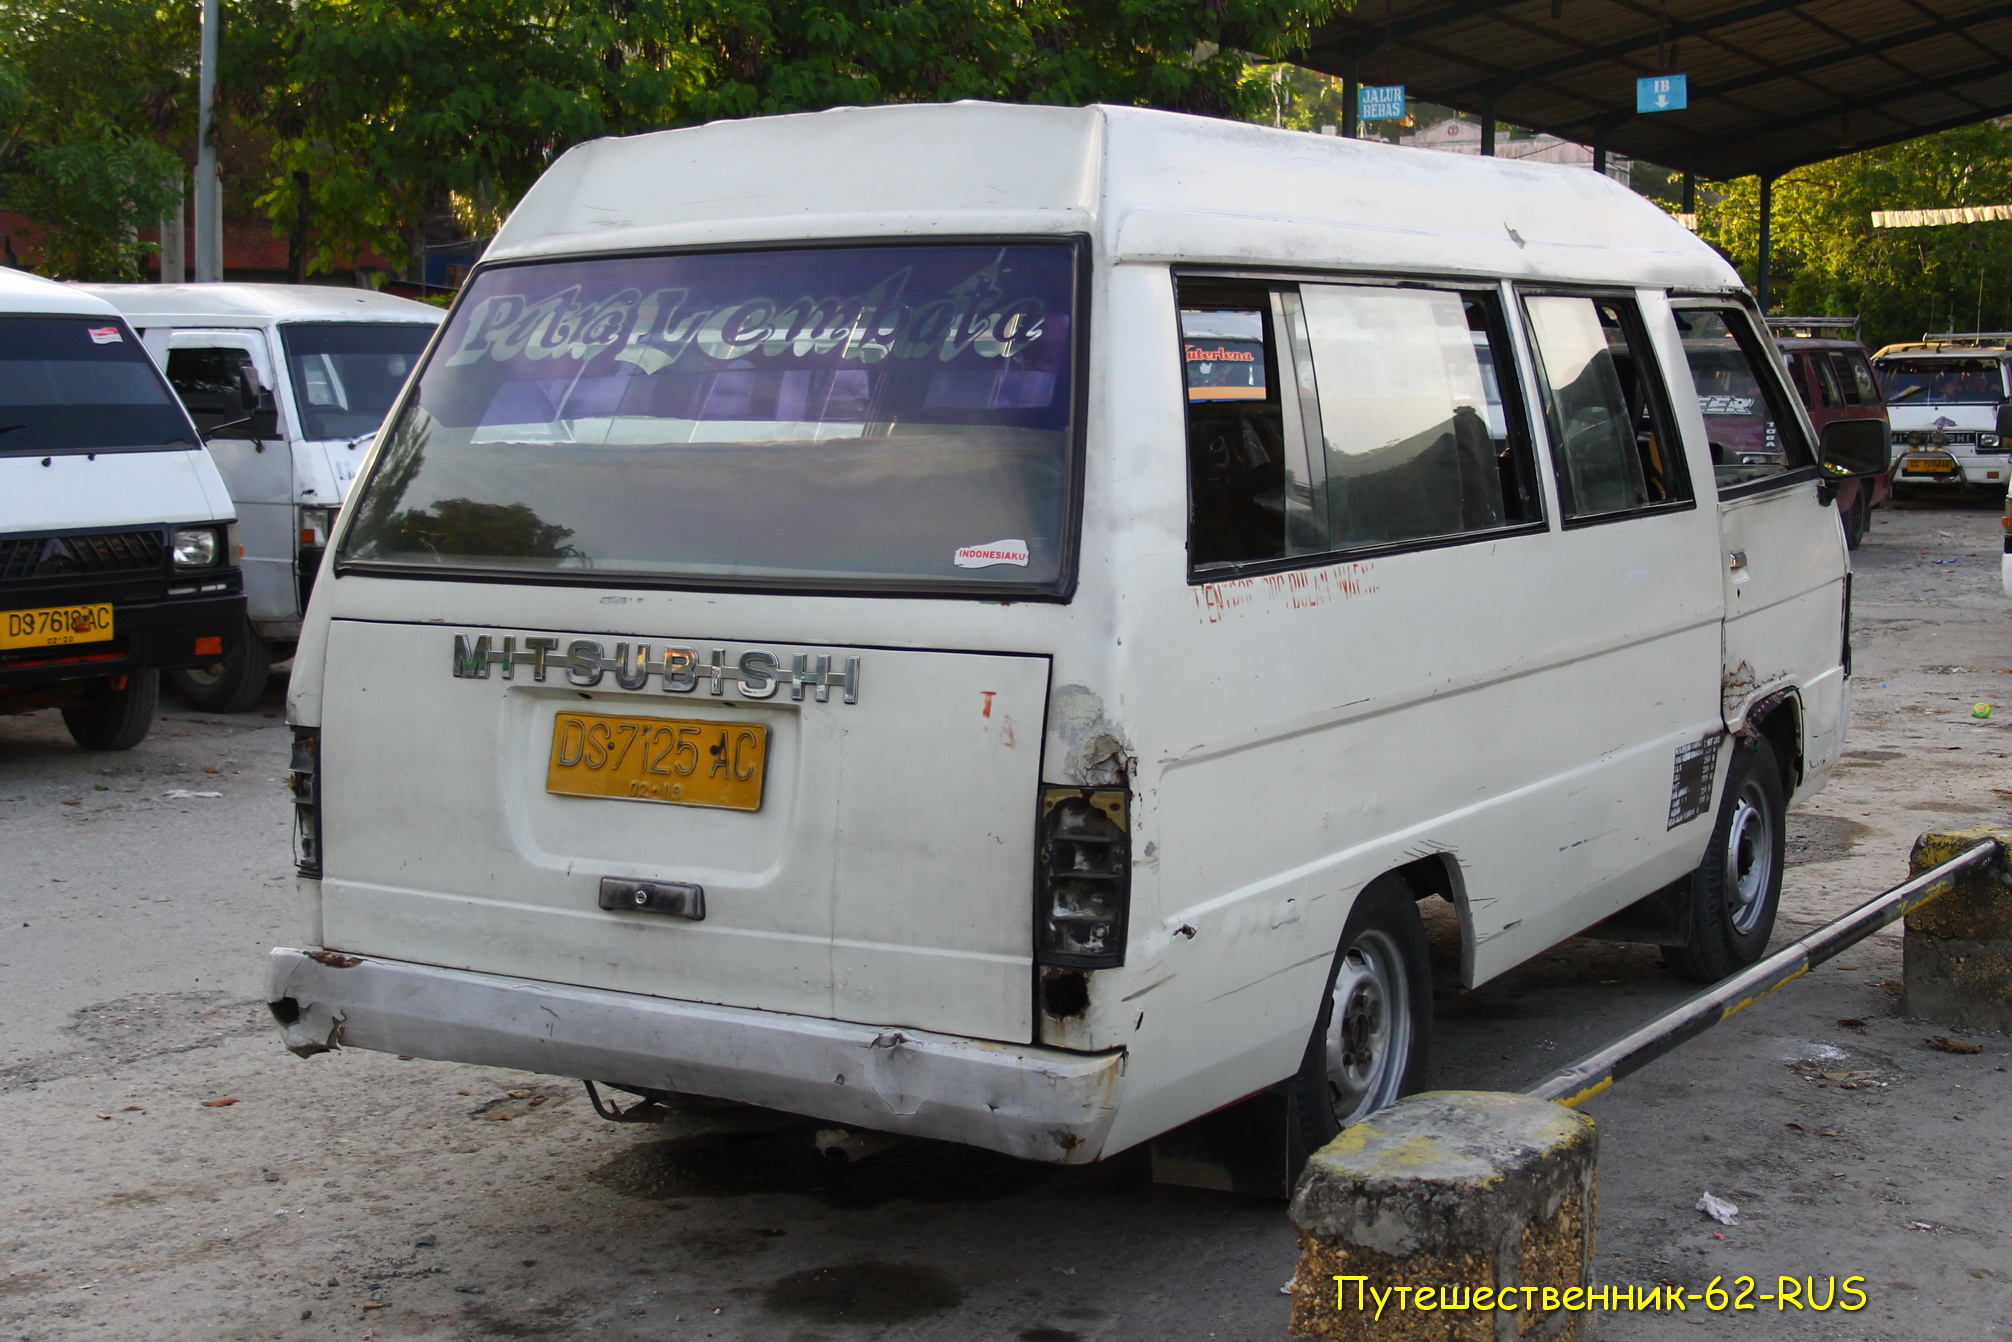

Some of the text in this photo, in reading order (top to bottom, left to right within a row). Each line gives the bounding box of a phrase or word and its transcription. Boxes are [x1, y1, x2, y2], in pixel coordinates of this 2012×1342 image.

[1654, 80, 1670, 93] IB
[1362, 88, 1402, 103] JALUR
[1363, 102, 1400, 118] BEBAS
[959, 550, 1026, 561] INDONESIAKU
[9, 613, 34, 637] DS
[87, 607, 110, 629] AC
[453, 632, 861, 704] MITSUBISHI
[559, 719, 757, 781] DS 7125 AC
